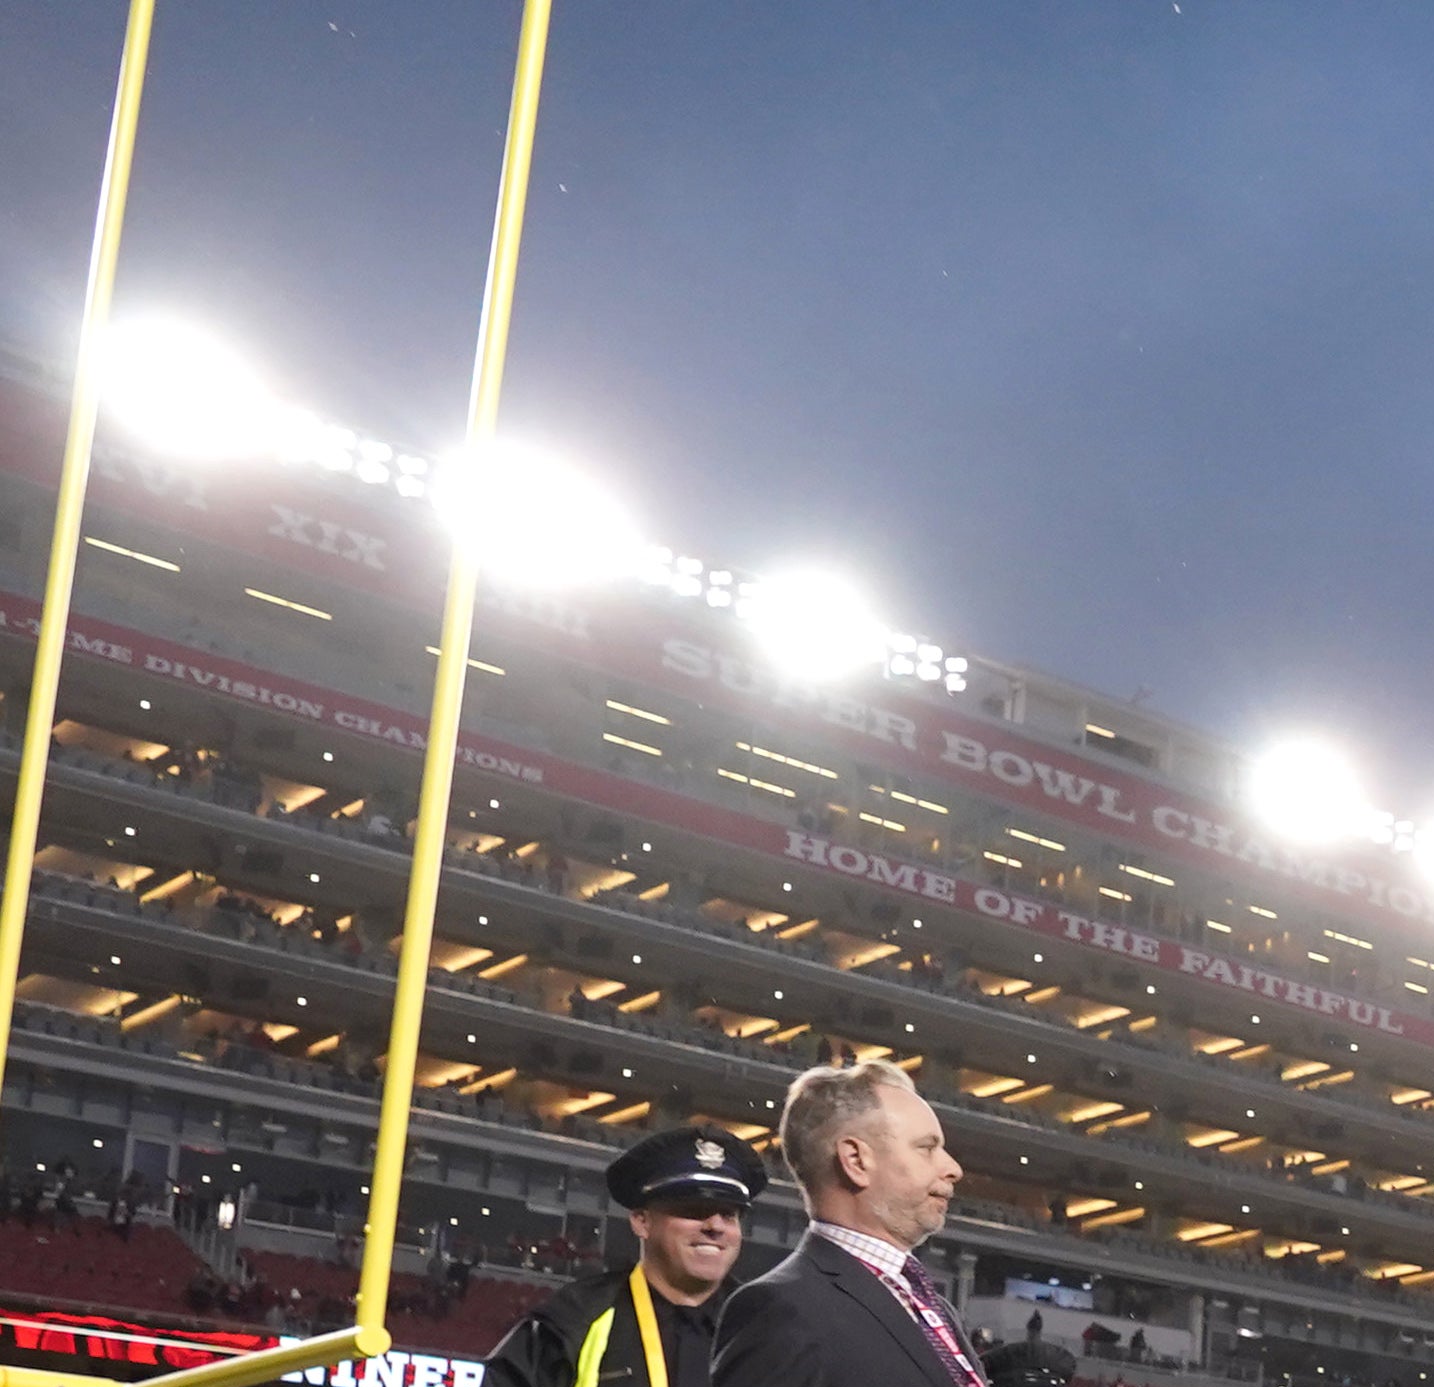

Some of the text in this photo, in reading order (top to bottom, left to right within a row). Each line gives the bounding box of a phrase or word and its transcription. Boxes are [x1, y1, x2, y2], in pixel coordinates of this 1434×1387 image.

[144, 654, 323, 720] DIVISION
[335, 711, 544, 783] CHAMIONS
[662, 638, 918, 751] SUER
[940, 729, 1137, 823] BOWL
[784, 830, 1405, 1034] HOME OF THE FAITHFUL
